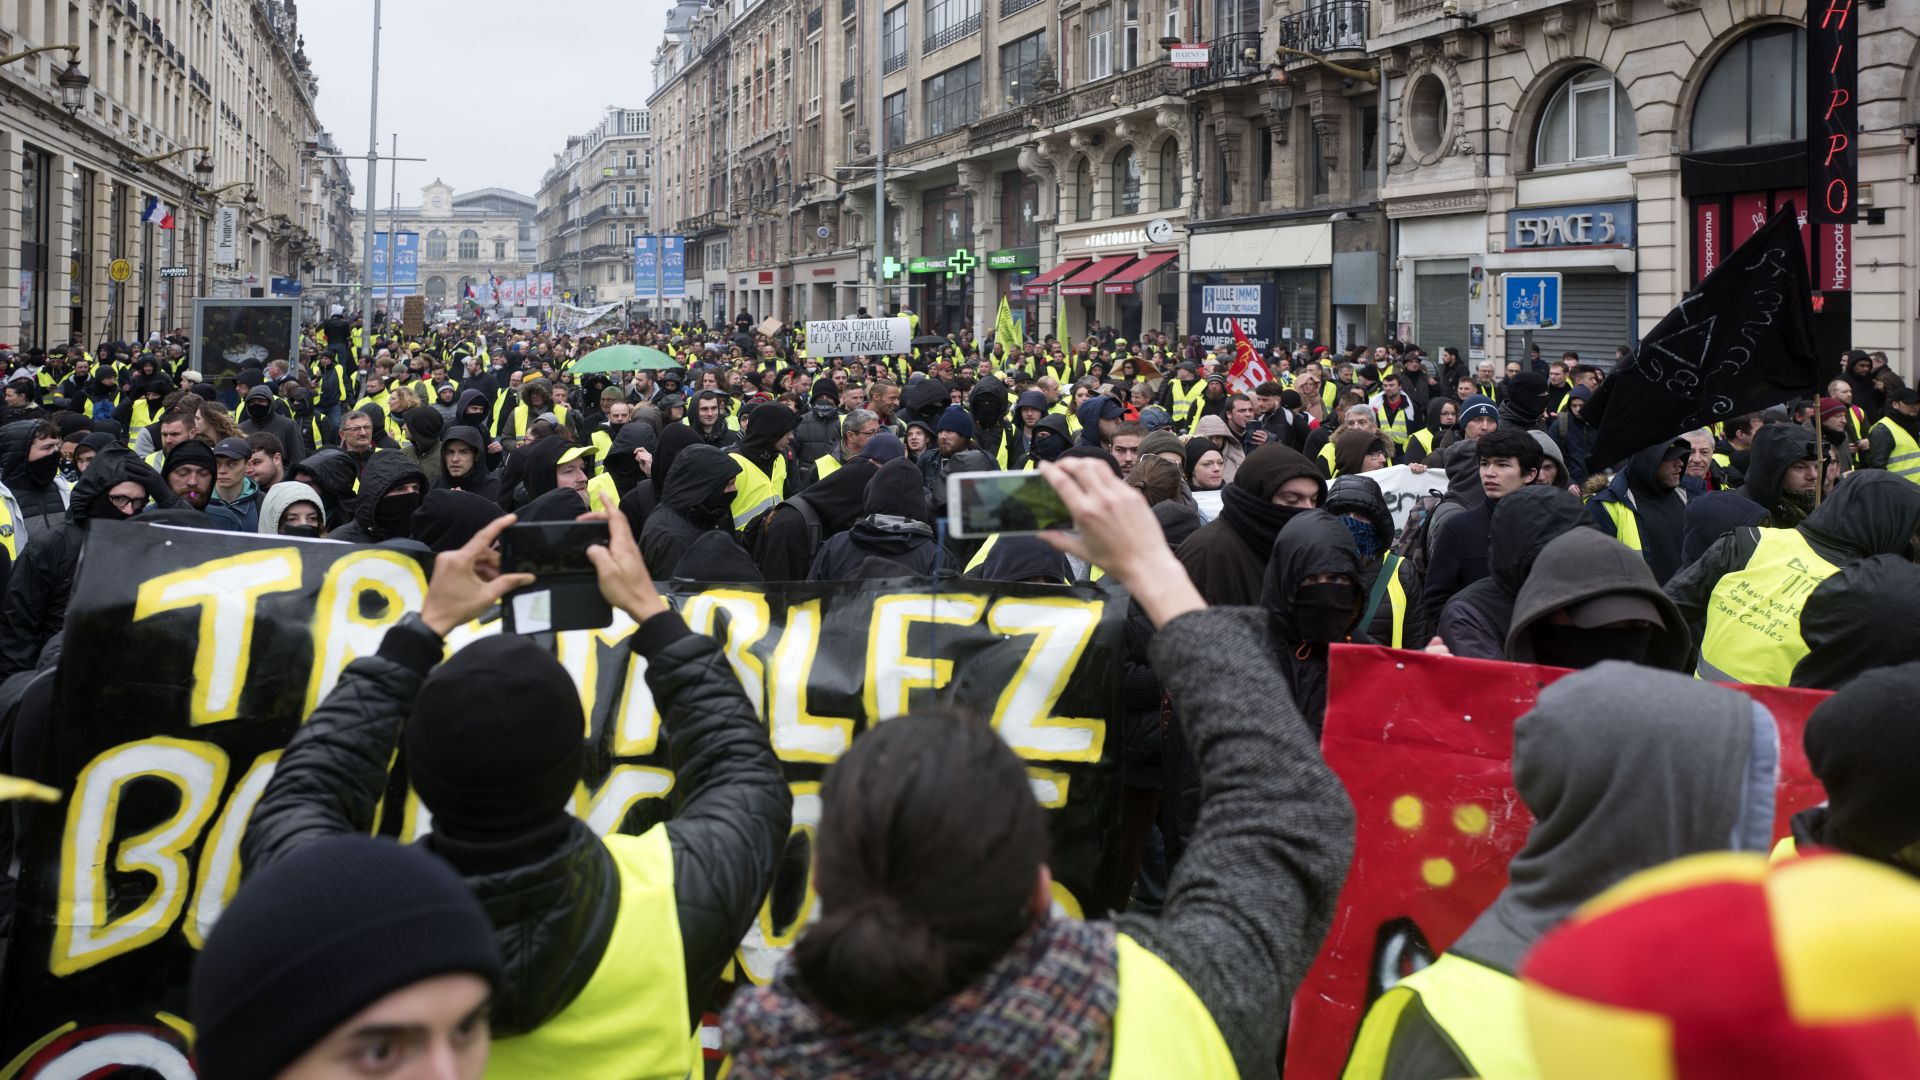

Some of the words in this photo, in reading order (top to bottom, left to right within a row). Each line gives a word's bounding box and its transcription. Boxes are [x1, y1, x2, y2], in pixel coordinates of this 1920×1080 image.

[1821, 0, 1851, 214] HIPPO
[219, 211, 233, 248] Promesse
[1515, 213, 1593, 246] ESPACE
[1598, 212, 1616, 242] 3
[991, 255, 1016, 264] PHARMACIE
[1832, 223, 1847, 289] hippopota
[1215, 287, 1234, 301] LILLE
[1235, 287, 1259, 302] IMMO
[1241, 304, 1259, 313] FINANCE
[811, 321, 848, 333] MACRON
[852, 319, 889, 331] COMPLICE
[1205, 317, 1214, 333] A
[811, 333, 818, 344] DE
[820, 333, 831, 343] LA
[834, 331, 852, 342] PIRE
[854, 330, 891, 342] RACAILLE
[827, 343, 842, 354] LA
[850, 340, 894, 353] FINANCE
[1772, 618, 1790, 630] que
